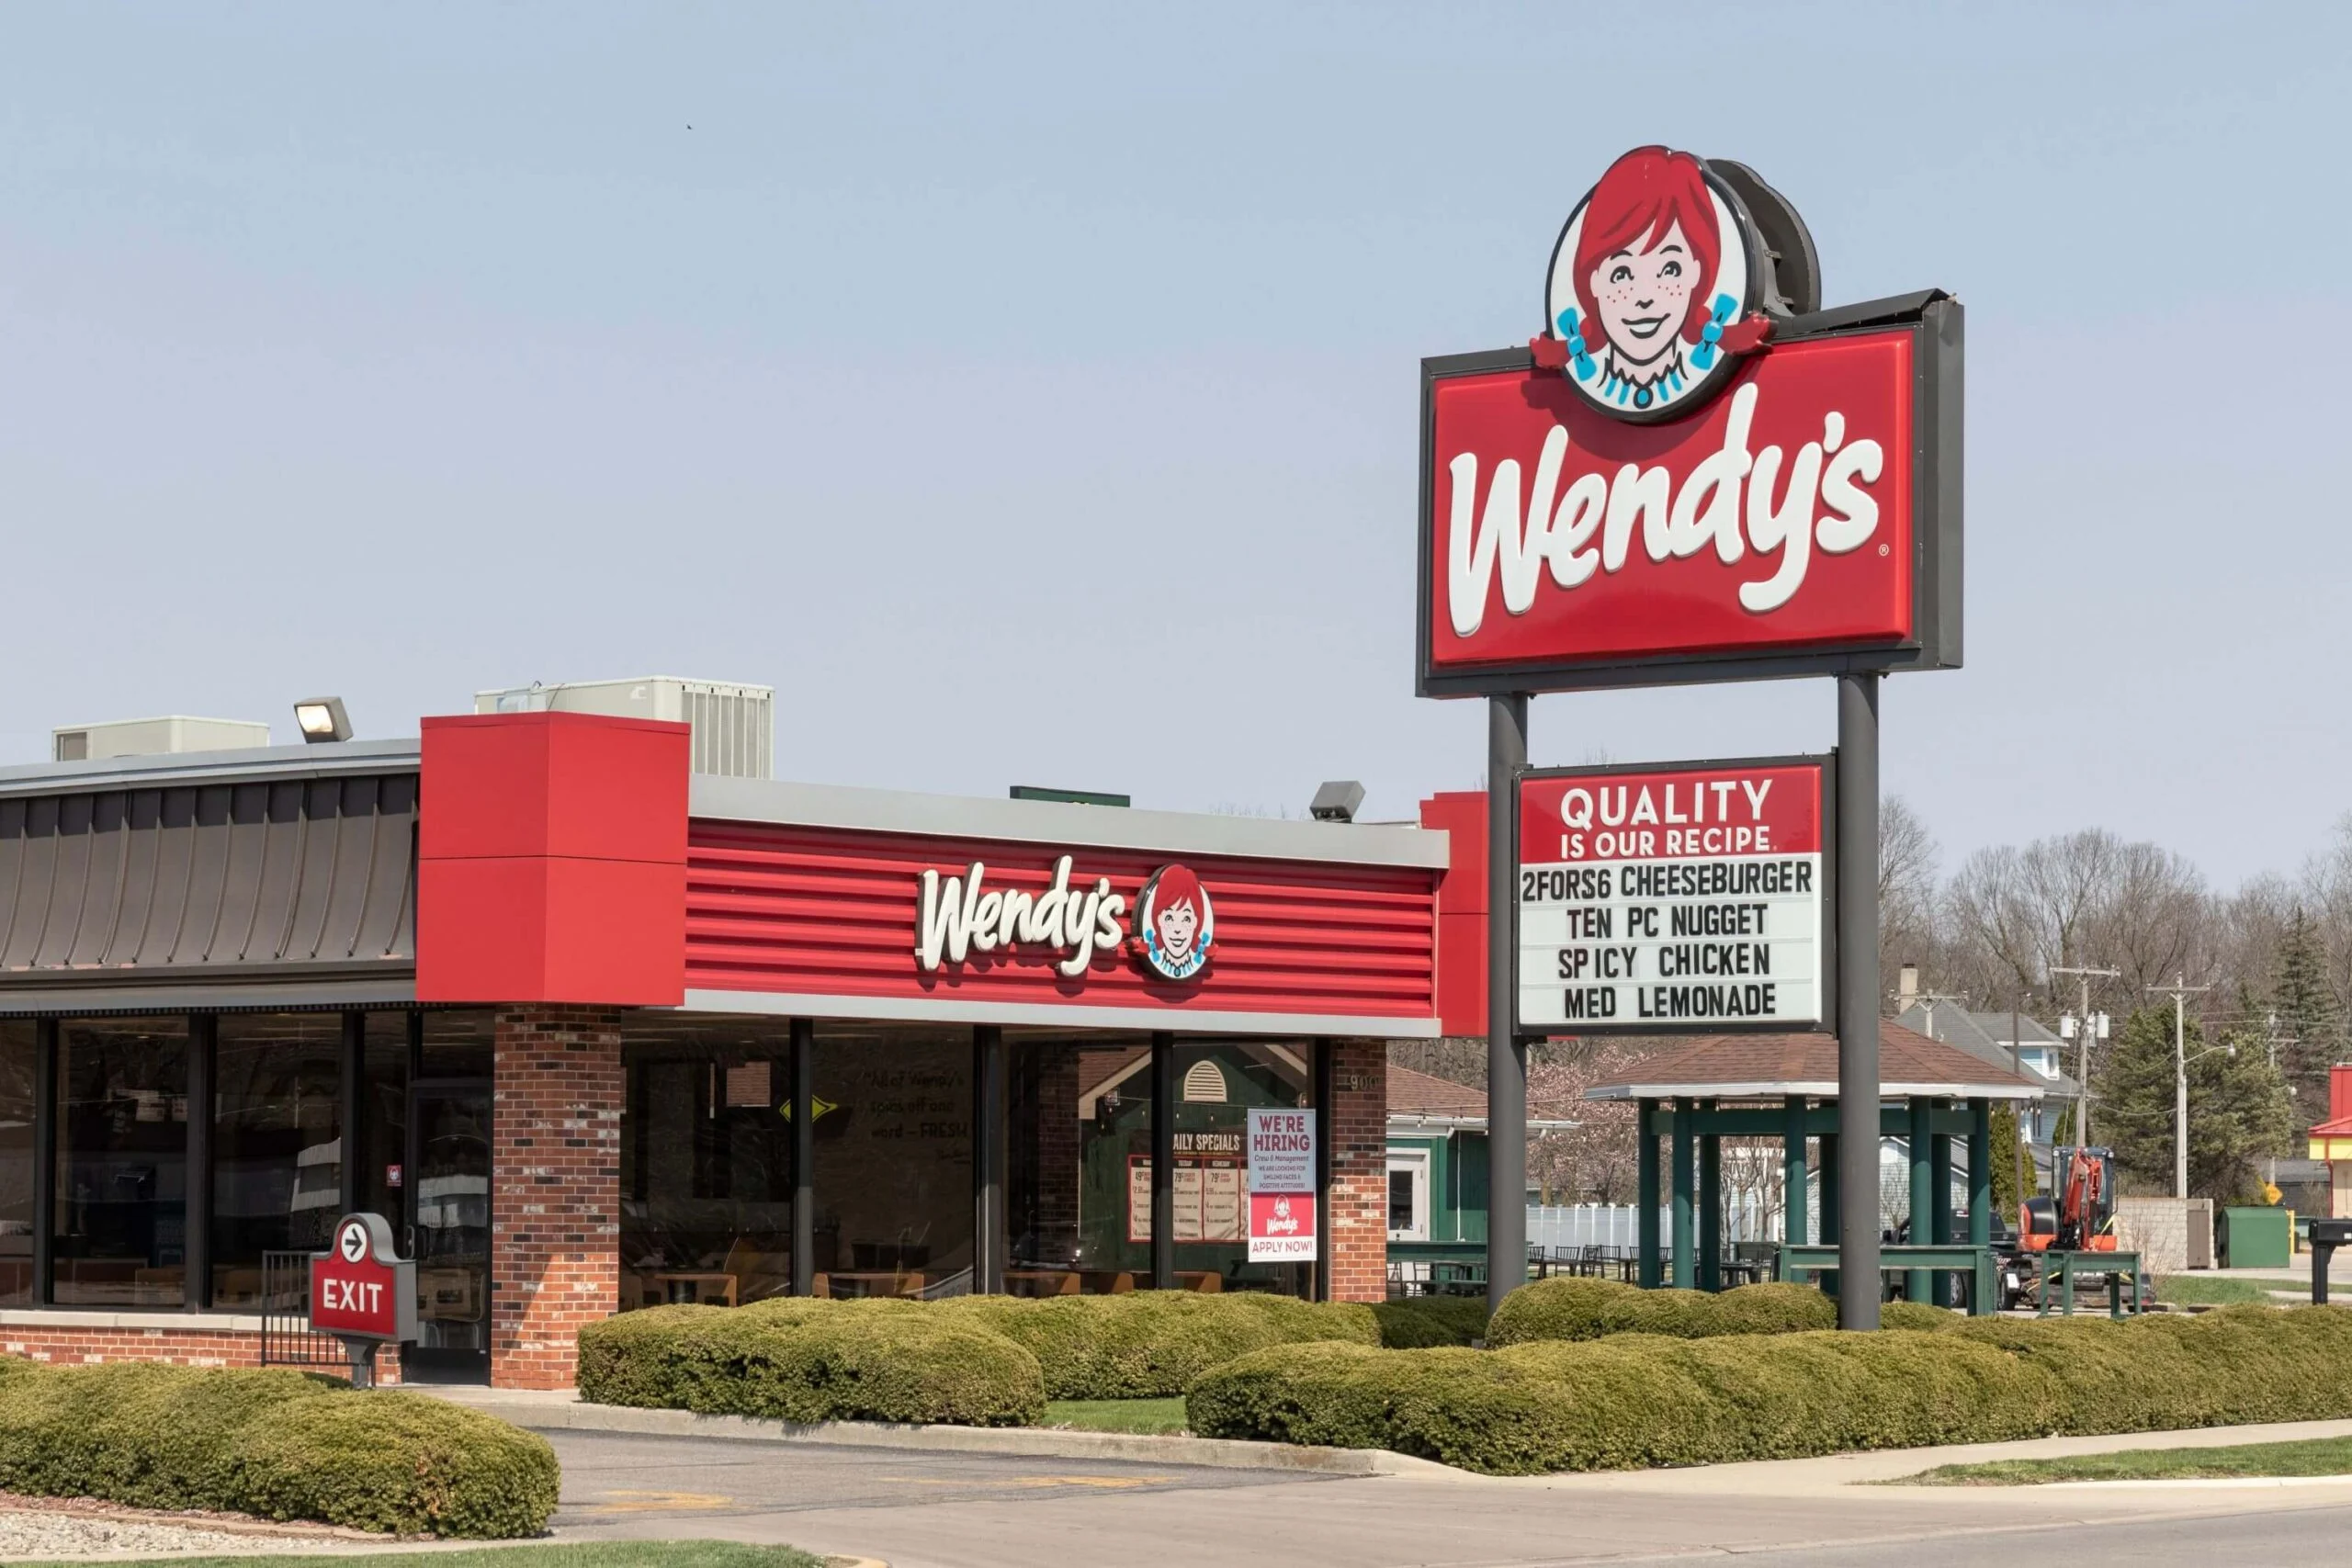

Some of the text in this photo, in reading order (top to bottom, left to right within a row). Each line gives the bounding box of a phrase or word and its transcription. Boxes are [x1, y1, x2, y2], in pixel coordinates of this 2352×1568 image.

[1449, 382, 1883, 637] Wendy's
[1560, 779, 1773, 832] QUALITY
[1561, 833, 1585, 860] IS
[1595, 830, 1656, 858] OUR
[1621, 861, 1812, 897] CHEESEBURGER
[922, 855, 1125, 976] Wendy's
[1566, 903, 1769, 939] TEN PC NUGGET
[1558, 942, 1770, 979] SPICY CHICKEN
[1565, 983, 1776, 1019] MED LEMONADE
[1259, 1115, 1305, 1133] WE'RE
[1172, 1134, 1240, 1151] AILY SPECIALS
[1253, 1134, 1310, 1152] HIRING
[1254, 1154, 1269, 1162] Crew
[1274, 1155, 1309, 1164] Management
[1267, 1214, 1298, 1235] Wendy's
[1252, 1241, 1313, 1253] APPLY NOW!
[323, 1279, 382, 1314] EXIT
